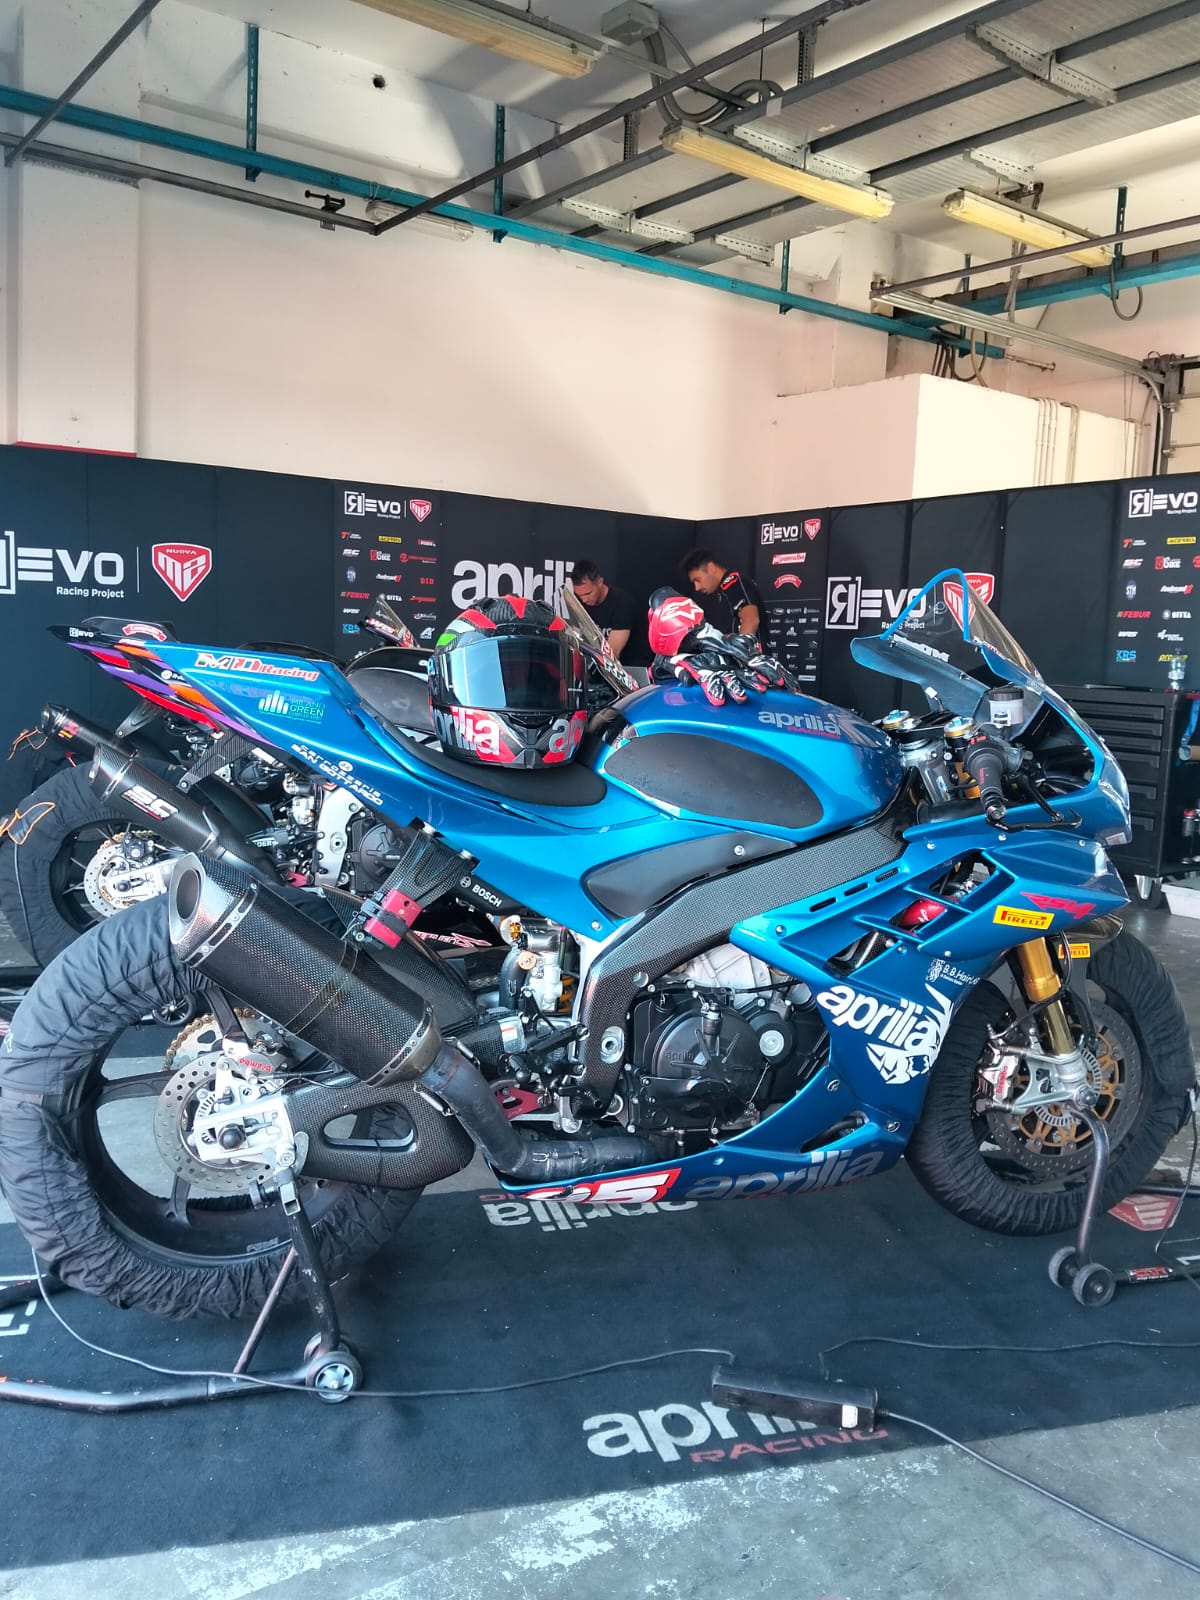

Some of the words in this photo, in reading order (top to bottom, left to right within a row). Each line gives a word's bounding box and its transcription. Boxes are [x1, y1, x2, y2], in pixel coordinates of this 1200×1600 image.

[166, 548, 197, 556] NUOVA
[0, 533, 124, 594] EVO
[56, 586, 90, 598] Racing
[92, 588, 125, 600] Project
[451, 560, 575, 619] aprili
[261, 664, 320, 682] Racing
[290, 705, 324, 717] GREEN
[758, 711, 841, 735] aprilia
[319, 761, 384, 806] GOTTARDO
[472, 884, 502, 905] BOSCH
[1000, 910, 1048, 927] PIRELLI
[816, 985, 931, 1051] aprilia
[238, 1056, 274, 1075] brembo
[685, 1149, 884, 1200] aprilia
[690, 1428, 889, 1464] RACING
